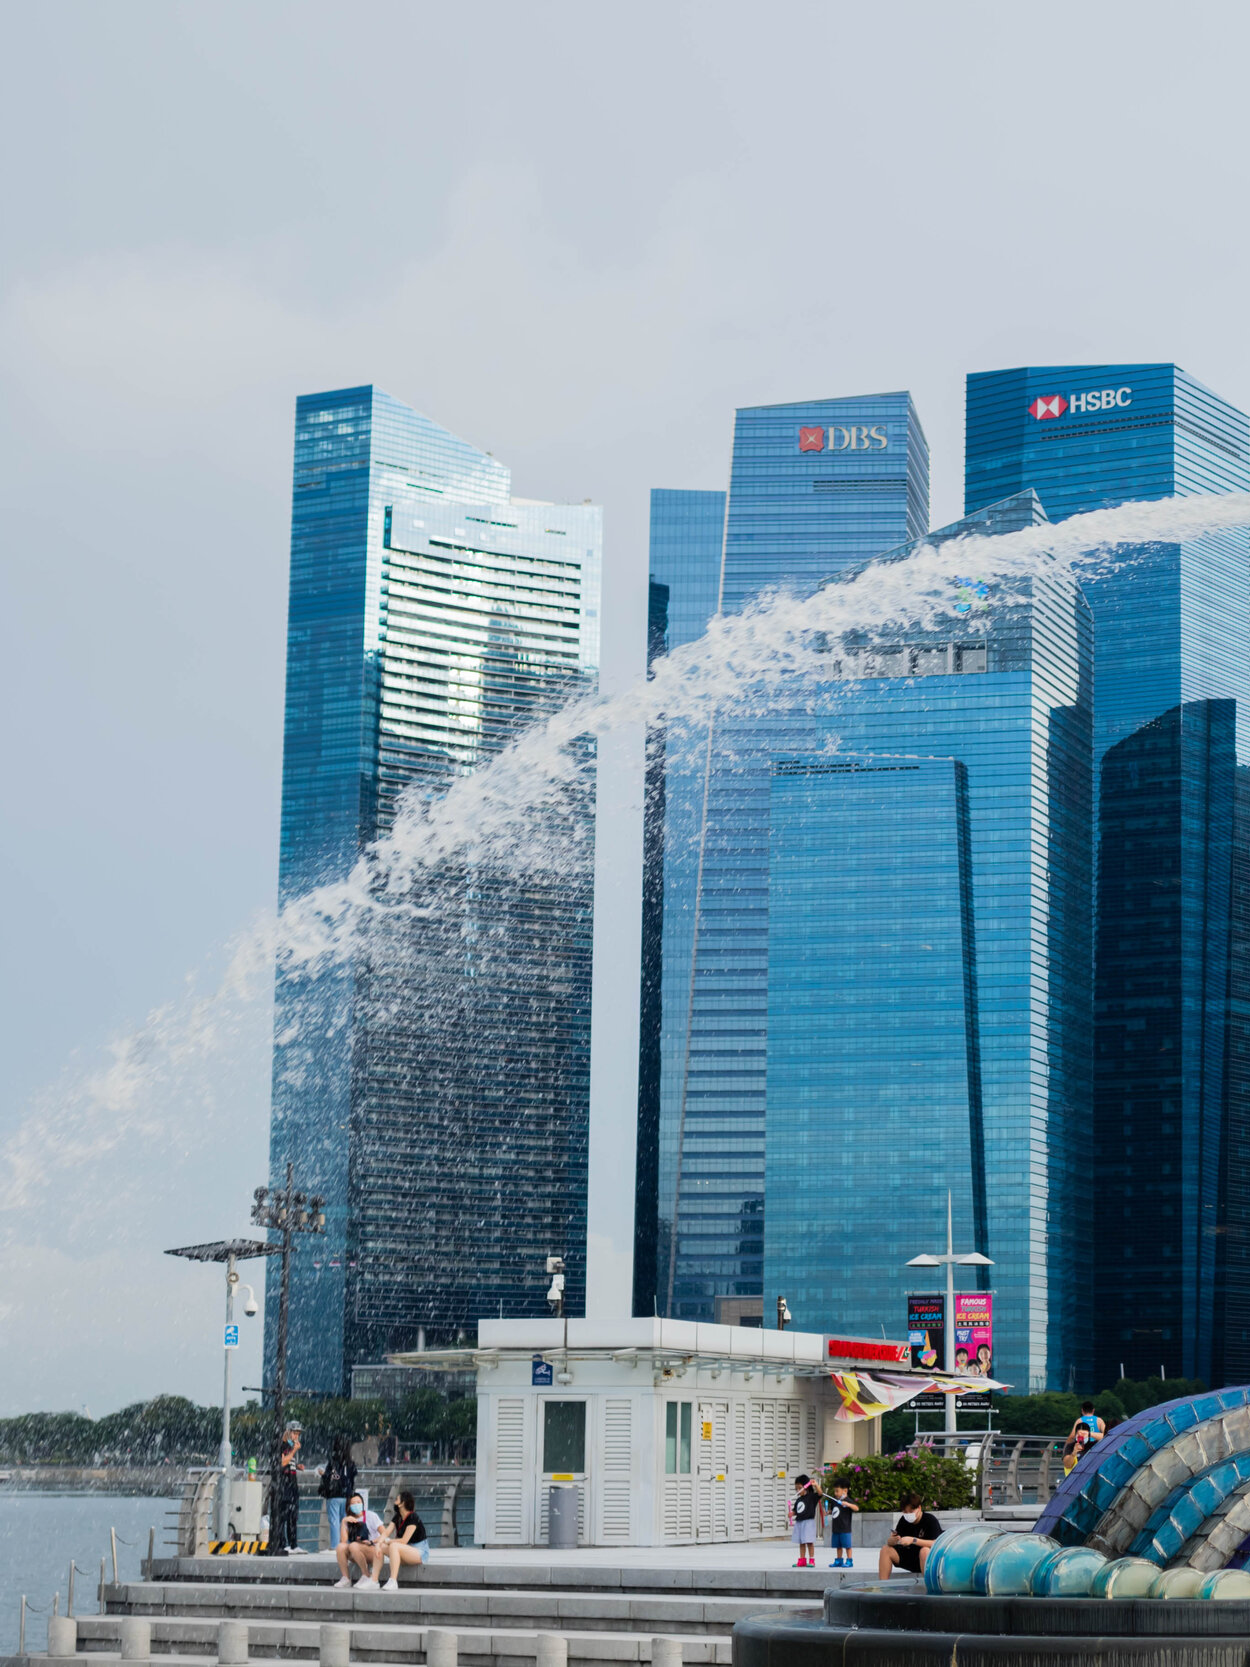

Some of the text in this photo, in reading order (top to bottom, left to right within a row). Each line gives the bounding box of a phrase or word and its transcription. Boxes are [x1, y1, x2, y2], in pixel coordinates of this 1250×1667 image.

[1070, 387, 1132, 413] HSBC
[828, 425, 888, 450] DBS
[920, 1312, 942, 1320] CREAM
[967, 1312, 990, 1320] CREAM
